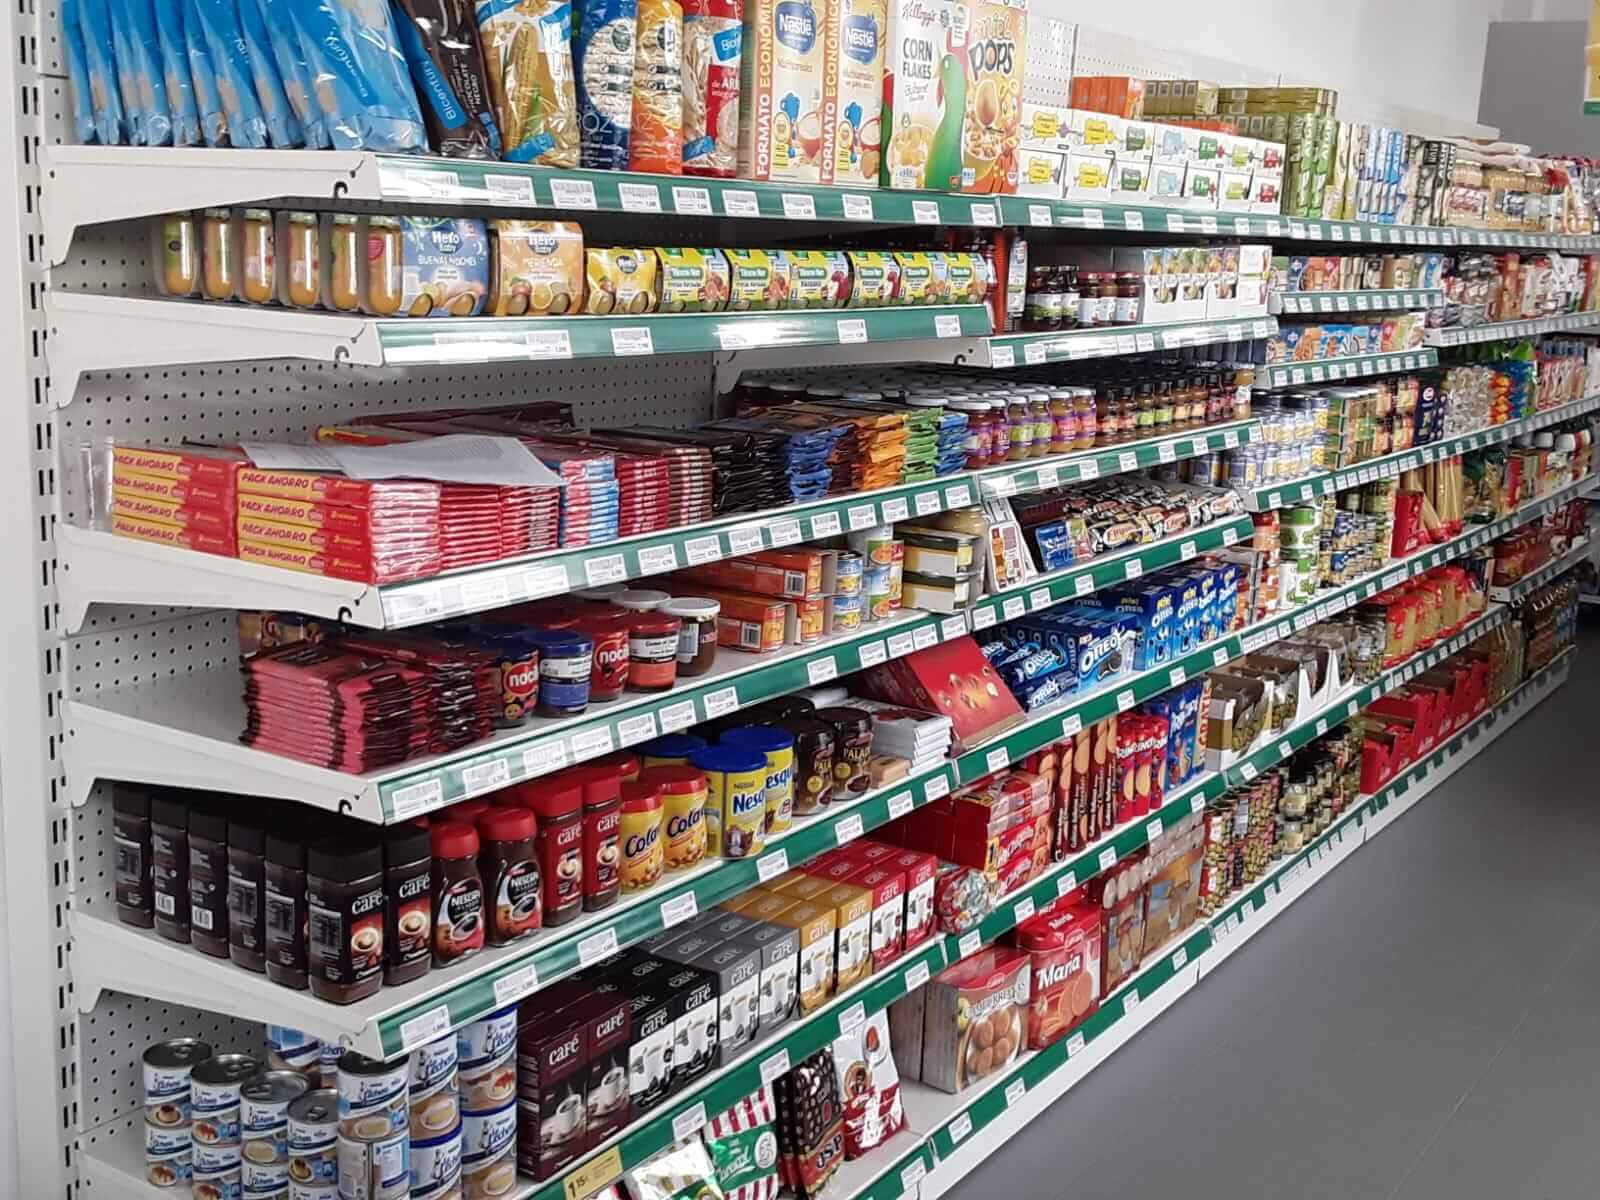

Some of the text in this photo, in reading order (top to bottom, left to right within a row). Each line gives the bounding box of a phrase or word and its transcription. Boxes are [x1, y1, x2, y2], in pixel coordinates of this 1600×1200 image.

[779, 13, 813, 37] Nestlé
[846, 27, 875, 49] Nestlé
[902, 37, 933, 62] CORN
[902, 61, 932, 80] FLAKES
[756, 94, 771, 177] FORMATO
[822, 102, 836, 180] FORMATO
[431, 230, 460, 244] Hero
[267, 475, 309, 489] AHORRO
[263, 503, 305, 518] AHORRO
[264, 526, 307, 542] AHORRO
[268, 548, 306, 565] AHORRO
[1080, 634, 1120, 673] OREO
[766, 768, 793, 789] esqu
[399, 872, 431, 899] café
[351, 887, 384, 915] café
[685, 983, 711, 1011] café
[596, 1007, 625, 1039] café
[640, 1008, 668, 1038] café
[548, 1034, 580, 1065] café
